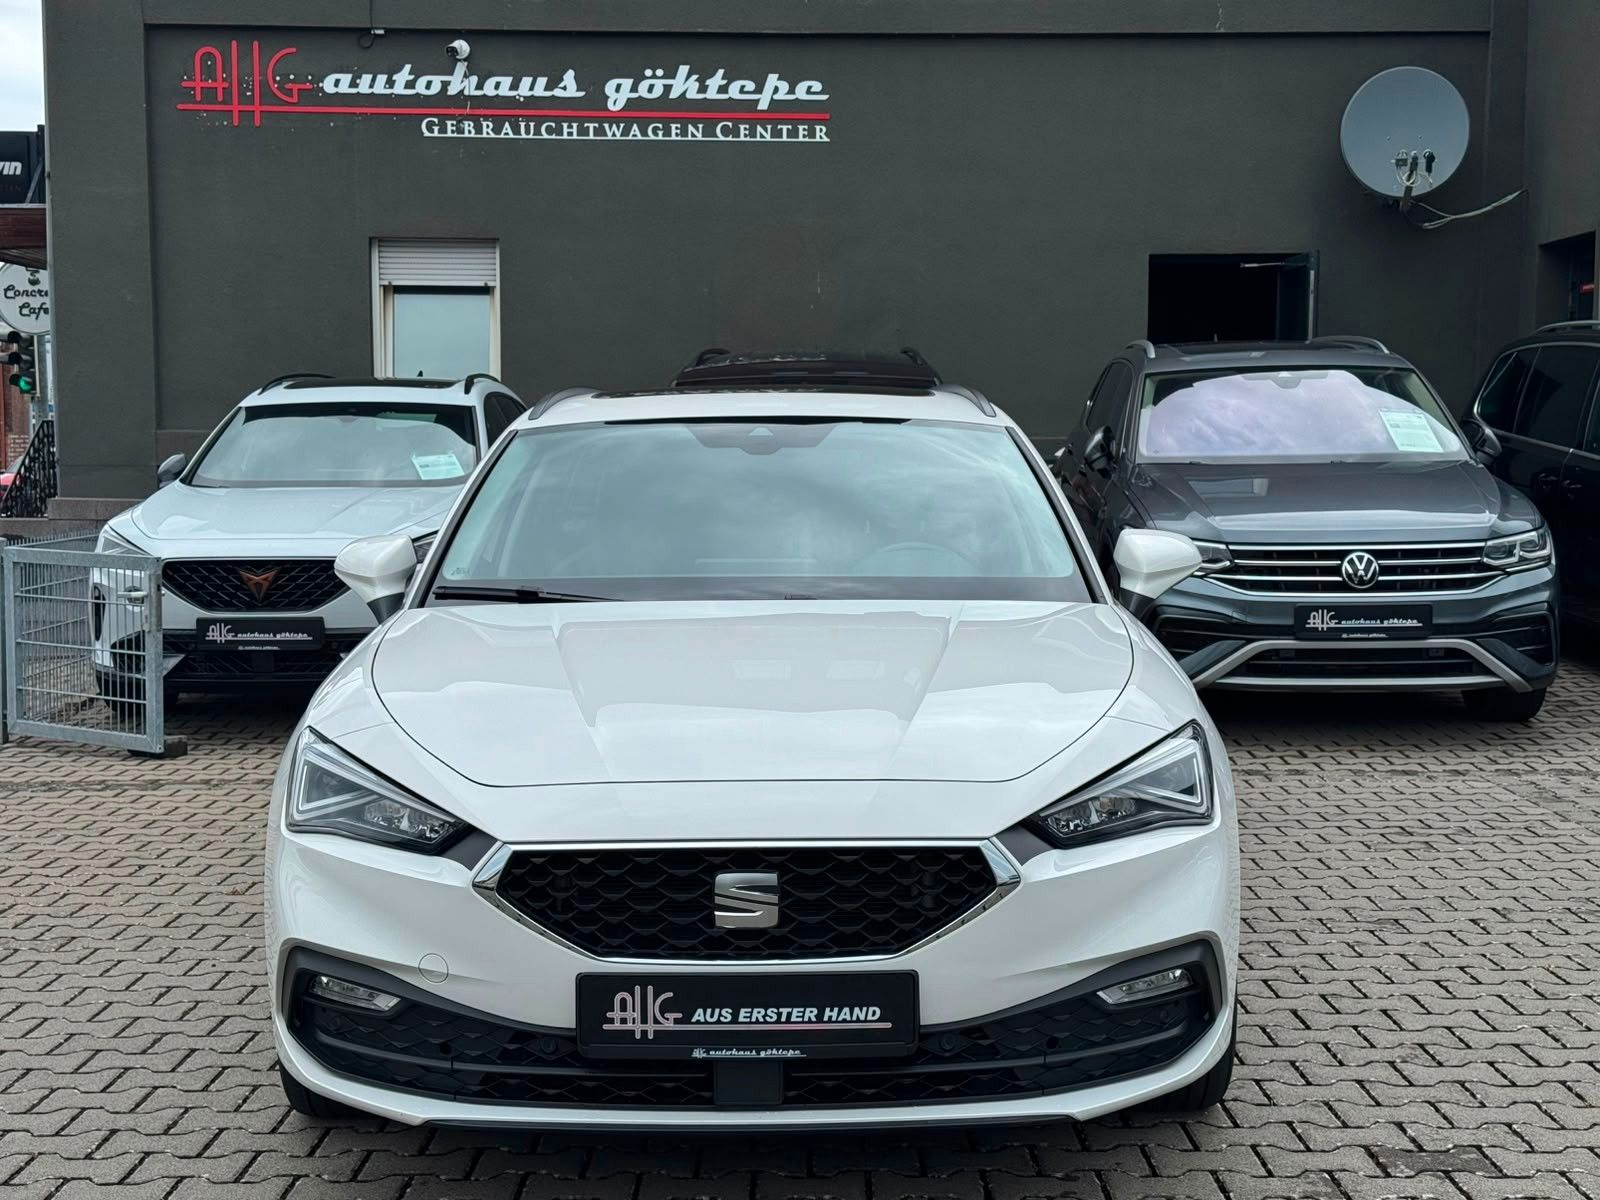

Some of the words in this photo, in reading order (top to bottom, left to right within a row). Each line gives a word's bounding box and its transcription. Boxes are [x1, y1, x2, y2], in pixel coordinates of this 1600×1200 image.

[323, 62, 586, 98] autohaus
[604, 64, 830, 112] göktepe
[715, 121, 831, 141] CENTER
[691, 1008, 733, 1023] AUS
[737, 1007, 817, 1023] ERSTER
[823, 1006, 882, 1022] HAND
[709, 1048, 757, 1056] autohaus
